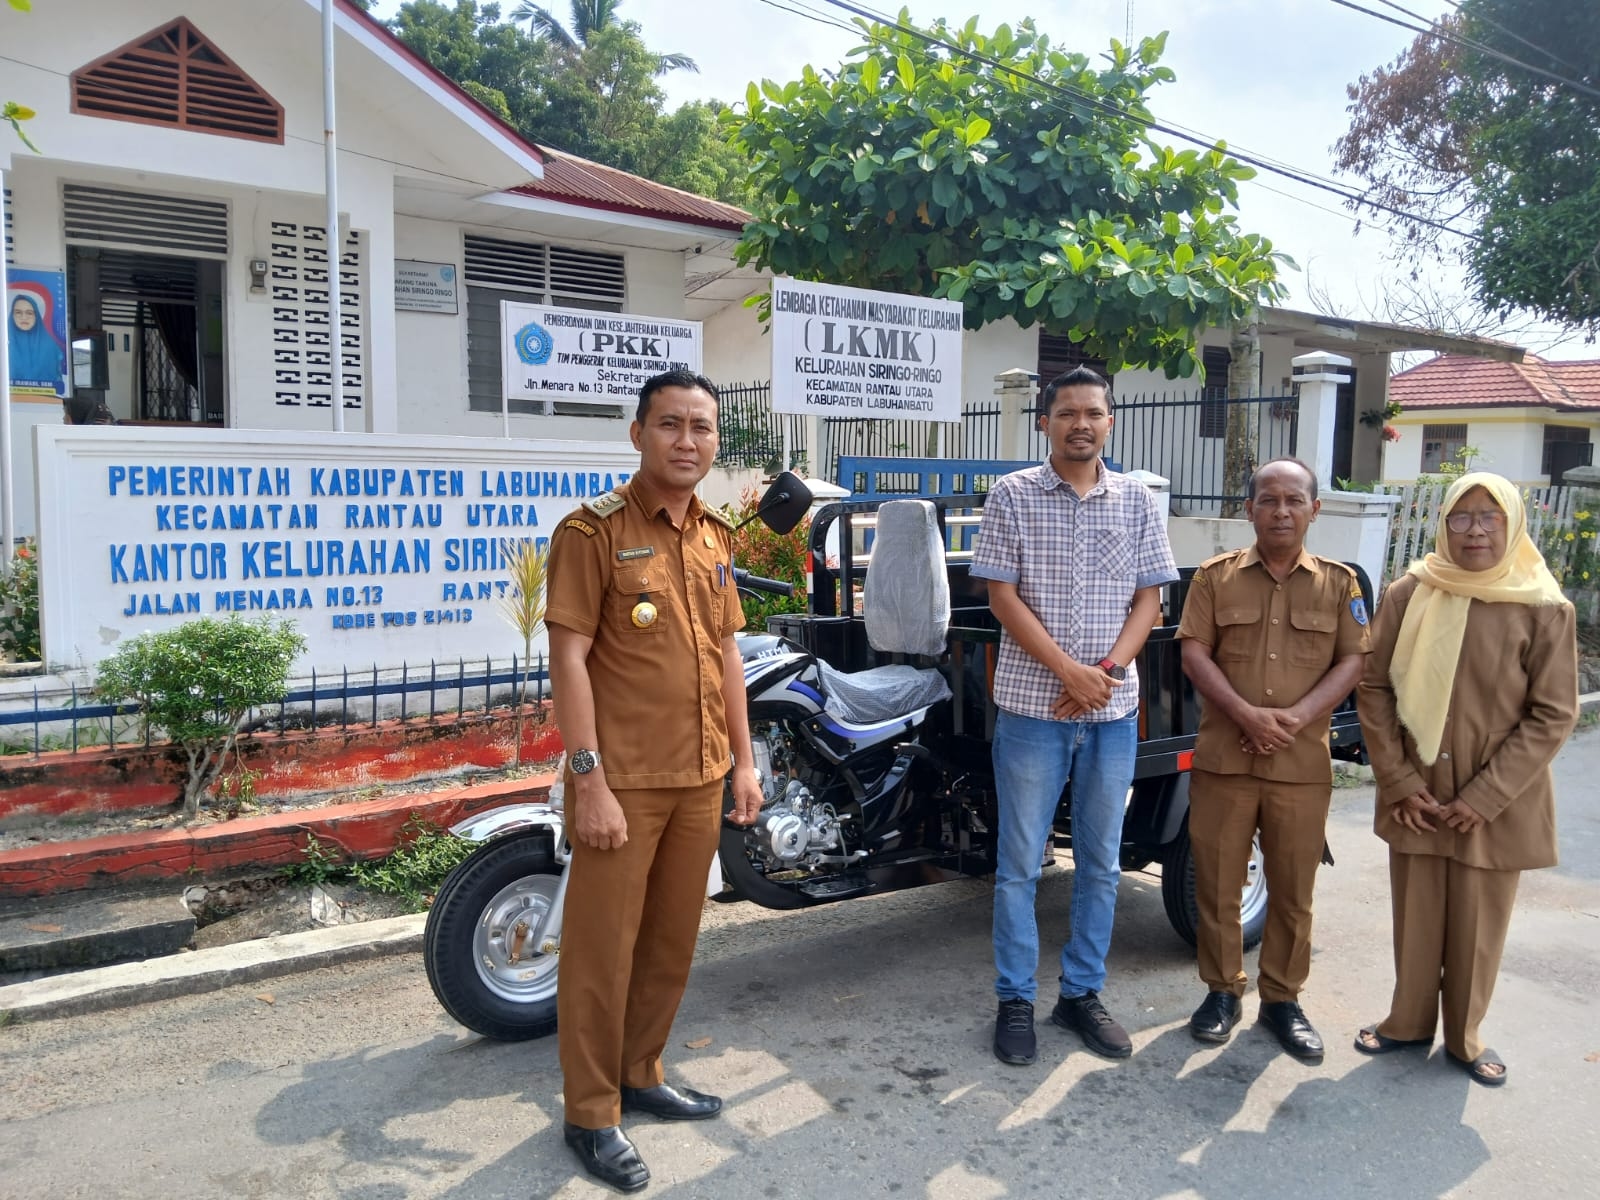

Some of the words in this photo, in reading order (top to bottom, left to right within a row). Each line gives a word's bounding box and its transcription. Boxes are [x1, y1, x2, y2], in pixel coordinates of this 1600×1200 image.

[776, 289, 817, 315] LEMBAGA
[819, 294, 867, 321] KETAHANAN
[868, 301, 917, 327] MASYARAKAT
[918, 308, 961, 332] KELURAHAN
[544, 313, 592, 329] PEMBERDAYAAN
[594, 318, 607, 331] DAN
[608, 320, 659, 336] KESEJAHTERAAN
[660, 326, 693, 339] KELUARGA
[557, 352, 570, 364] TIM
[571, 353, 606, 367] PENGGERAK
[607, 356, 643, 370] KELURAHAN
[795, 356, 866, 377] KELURAHAN
[869, 363, 942, 384] SIRINGO-RINGO
[806, 378, 862, 394] KECAMATAN
[866, 383, 901, 396] RANTAU
[905, 386, 934, 398] UTARA
[806, 393, 863, 408] KABUPATEN
[867, 397, 934, 411] LABUHANBATU
[108, 466, 290, 496] PEMERINTAH
[310, 467, 464, 497] KABUPATEN
[155, 504, 318, 531] KECAMATAN
[345, 504, 442, 528] RANTAU
[467, 504, 539, 527] UTARA
[109, 542, 227, 583] KANTOR
[242, 538, 430, 580] KELURAHAN
[123, 592, 201, 617] JALAN
[215, 588, 313, 612] MENARA
[326, 585, 383, 607] NO.13
[383, 611, 417, 627] POS
[424, 608, 473, 626] 21413
